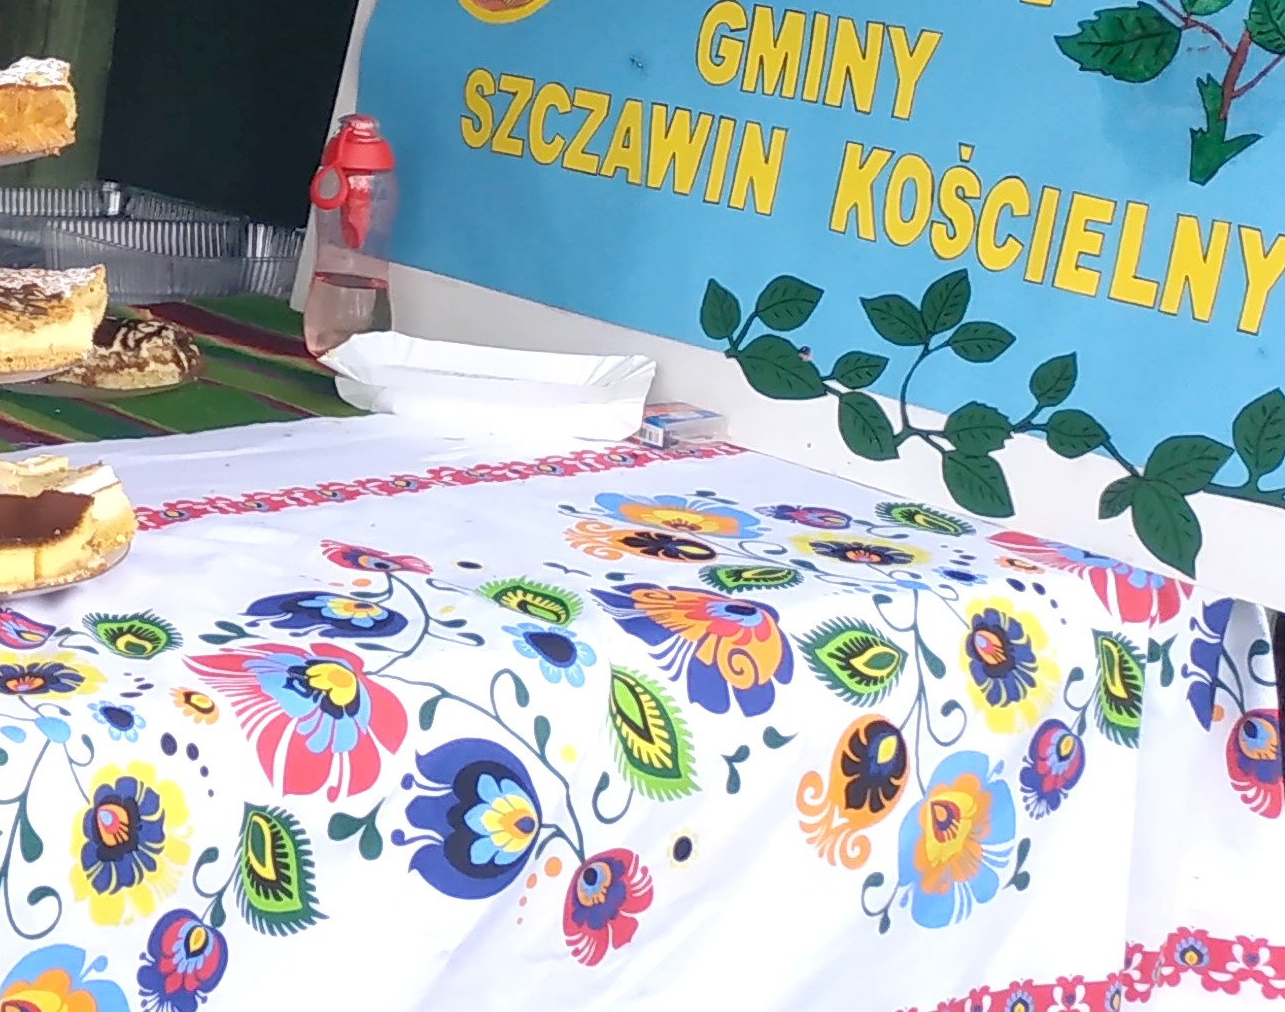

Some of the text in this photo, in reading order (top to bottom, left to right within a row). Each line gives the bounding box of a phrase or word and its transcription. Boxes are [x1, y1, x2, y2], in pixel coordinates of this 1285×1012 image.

[696, 0, 941, 120] GMINY
[460, 68, 1285, 336] SZCZAWIN KOŚCIELNY
